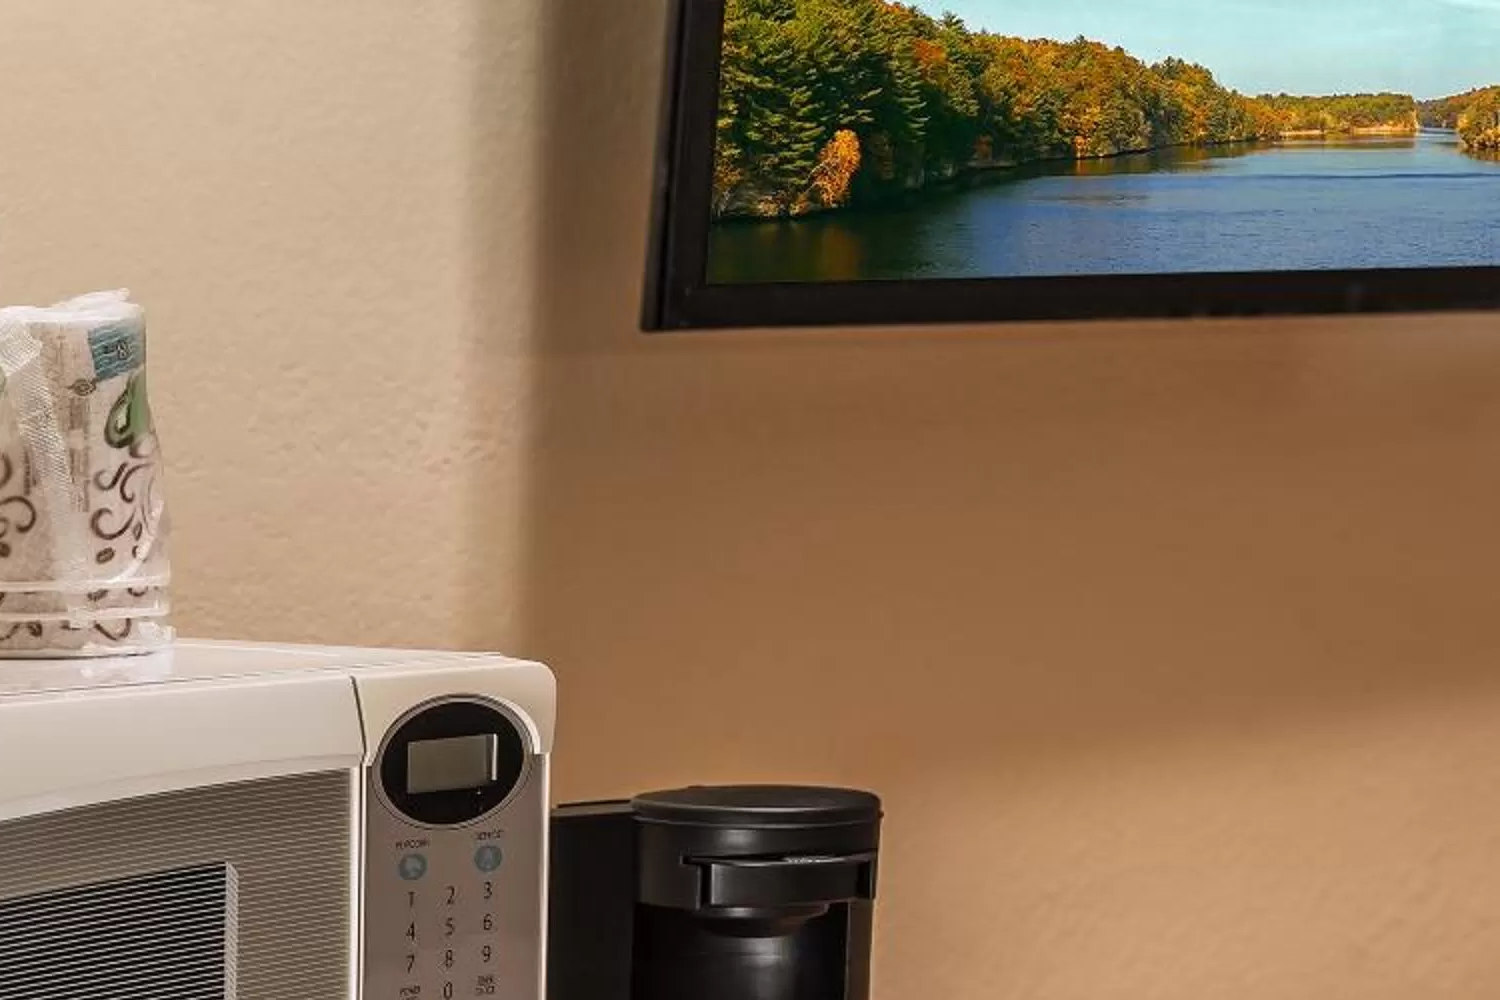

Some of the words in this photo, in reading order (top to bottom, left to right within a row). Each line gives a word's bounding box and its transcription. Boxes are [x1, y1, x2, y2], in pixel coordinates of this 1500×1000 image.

[407, 891, 416, 908] 1
[446, 885, 456, 905] 2
[483, 881, 493, 900] 3
[405, 921, 415, 941] 4
[445, 917, 455, 936] 5
[483, 913, 493, 931] 6
[406, 953, 415, 974] 7
[445, 949, 453, 969] 8
[482, 945, 492, 963] 9
[443, 981, 453, 1000] 0
